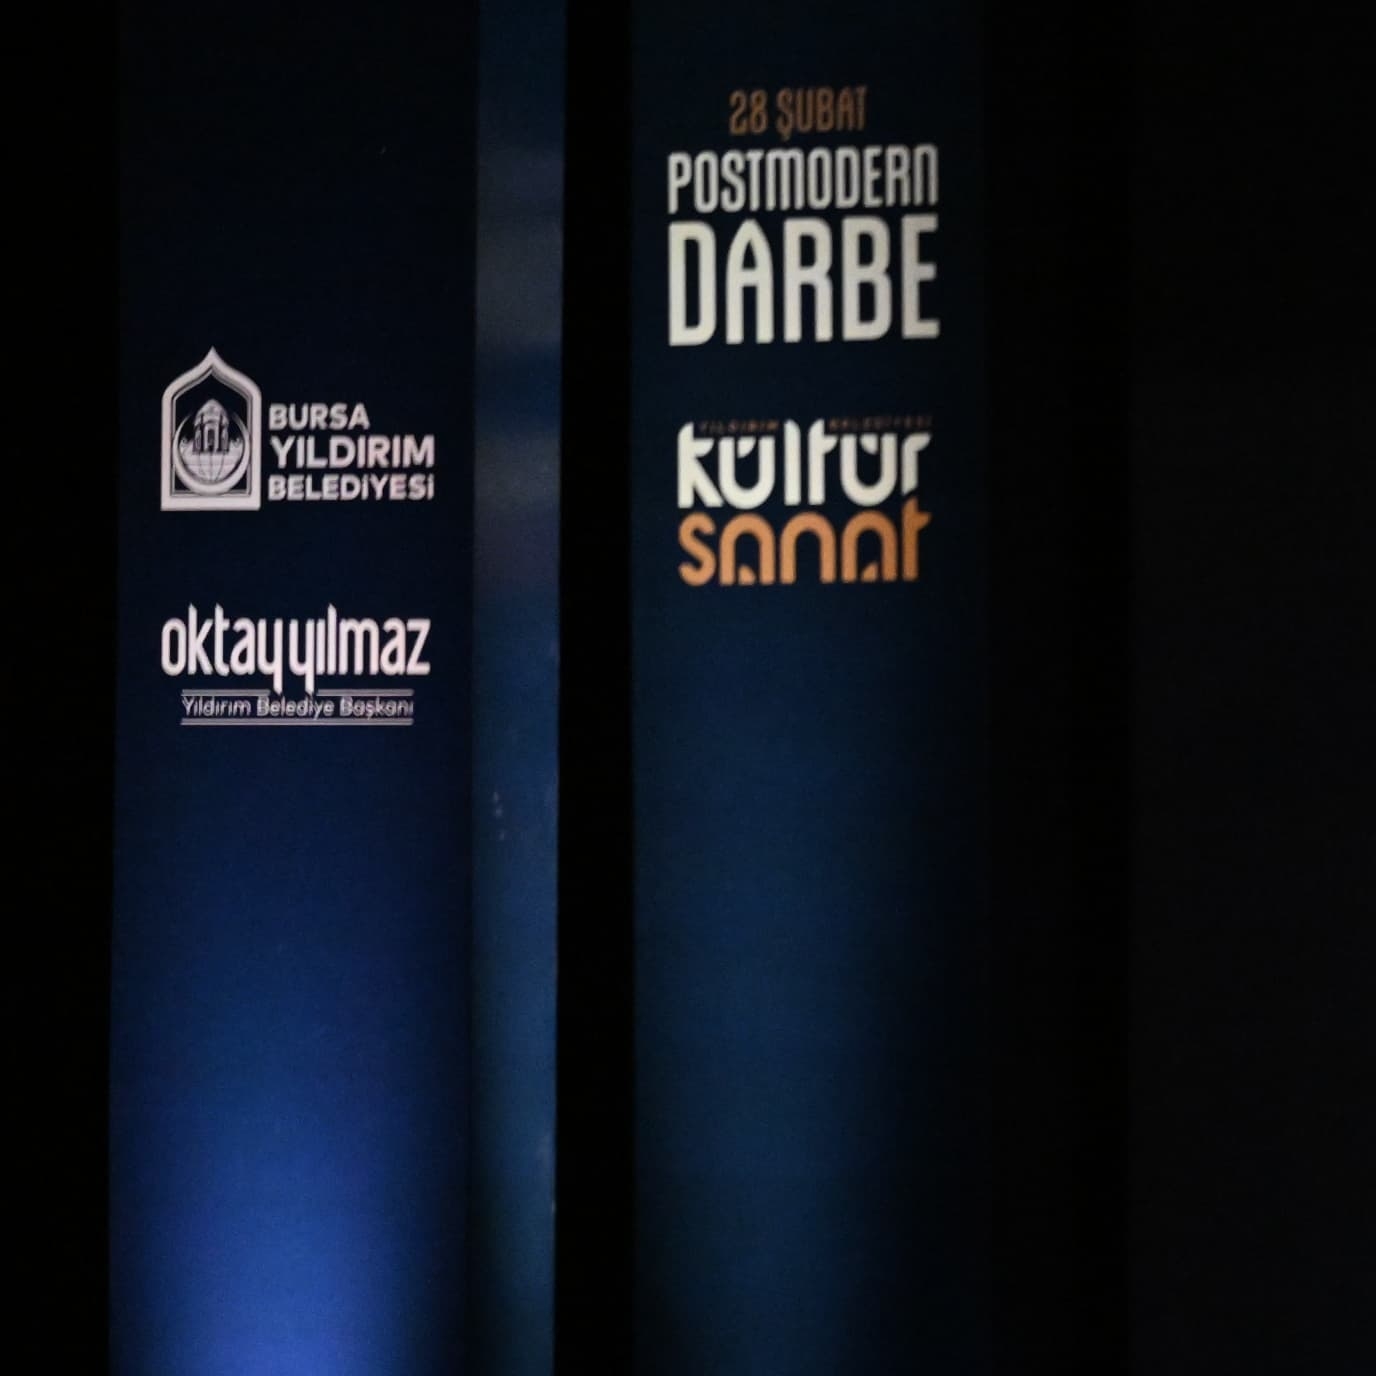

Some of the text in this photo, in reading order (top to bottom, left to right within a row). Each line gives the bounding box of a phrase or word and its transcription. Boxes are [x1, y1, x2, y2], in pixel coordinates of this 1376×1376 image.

[729, 85, 867, 141] 28 ŞUBAT
[667, 143, 938, 214] POSTMODERN
[669, 213, 940, 346] DARBE
[268, 403, 370, 430] BURSA
[270, 434, 435, 468] YILDIRIM
[678, 496, 932, 586] sanat
[257, 696, 335, 720] Belediye
